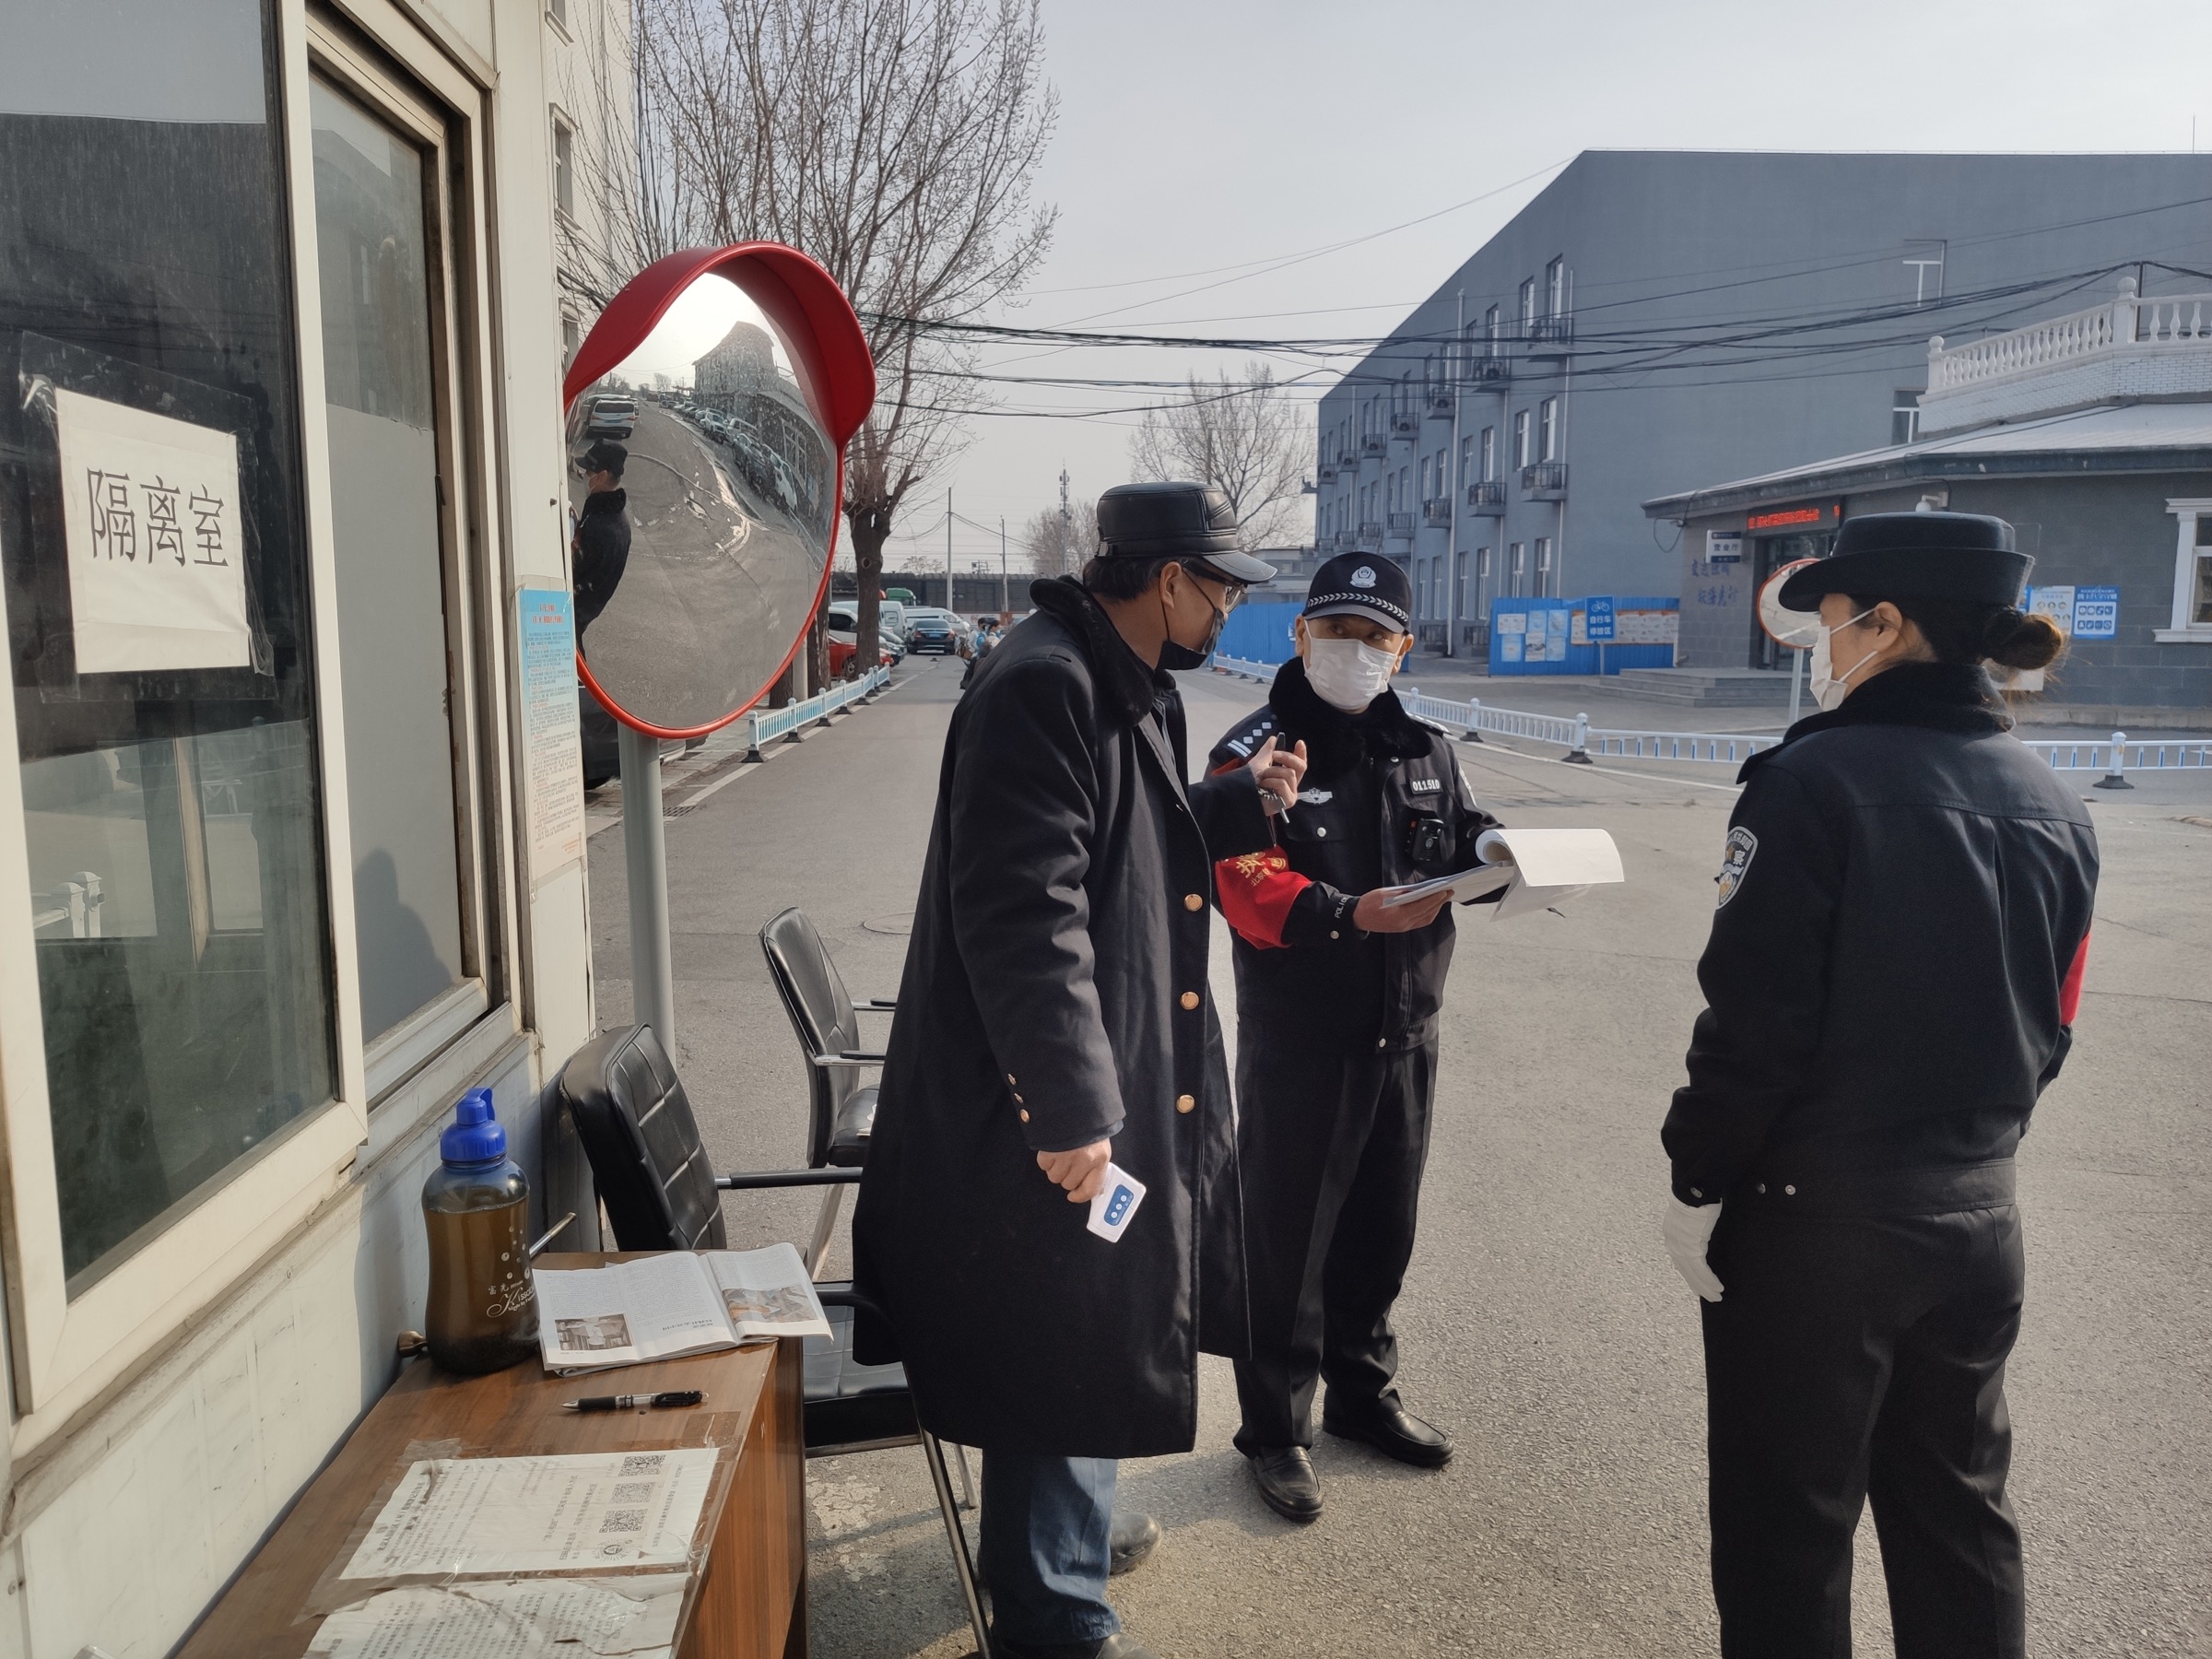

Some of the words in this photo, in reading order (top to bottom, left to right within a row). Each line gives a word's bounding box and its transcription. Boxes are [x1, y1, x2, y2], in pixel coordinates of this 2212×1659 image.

[87, 466, 229, 568] 隔离室
[1713, 543, 1739, 551] 营业厅
[1589, 615, 1611, 624] 自行车
[1412, 779, 1441, 792] 011510
